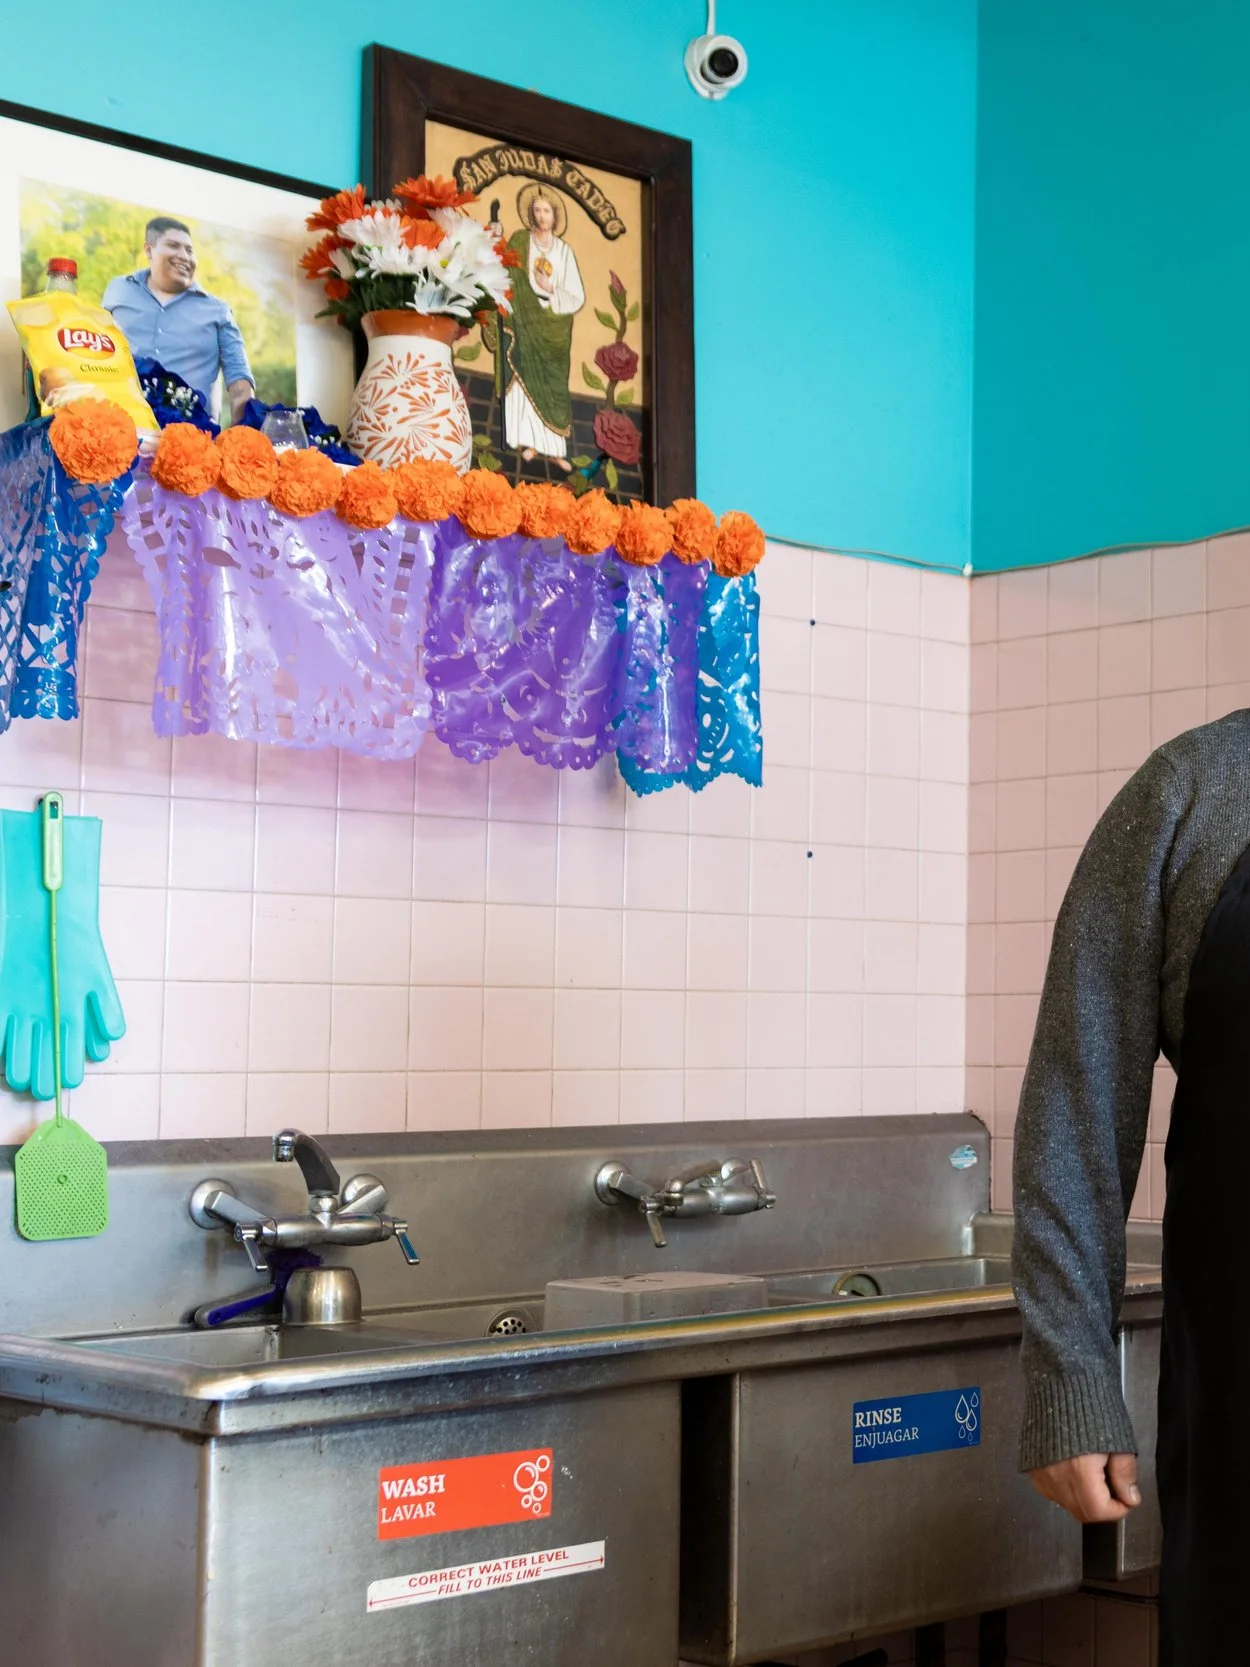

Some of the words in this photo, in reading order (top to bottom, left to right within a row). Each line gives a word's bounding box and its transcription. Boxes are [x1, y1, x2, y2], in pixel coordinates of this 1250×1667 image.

[460, 153, 498, 192] SAN
[499, 149, 562, 177] JUDAS
[64, 328, 112, 352] Lay's
[80, 363, 120, 374] Classic
[855, 1407, 902, 1428] RINSE
[855, 1427, 919, 1448] ENJUAGAR
[381, 1474, 445, 1500] WASH
[381, 1501, 436, 1524] LAVAR
[408, 1567, 474, 1588] CORRECT
[479, 1558, 527, 1575] WATER
[531, 1550, 569, 1565] LEVEL
[438, 1580, 462, 1595] FILL
[467, 1577, 482, 1589] TO
[487, 1573, 512, 1585] THIS
[516, 1567, 541, 1580] LINE
